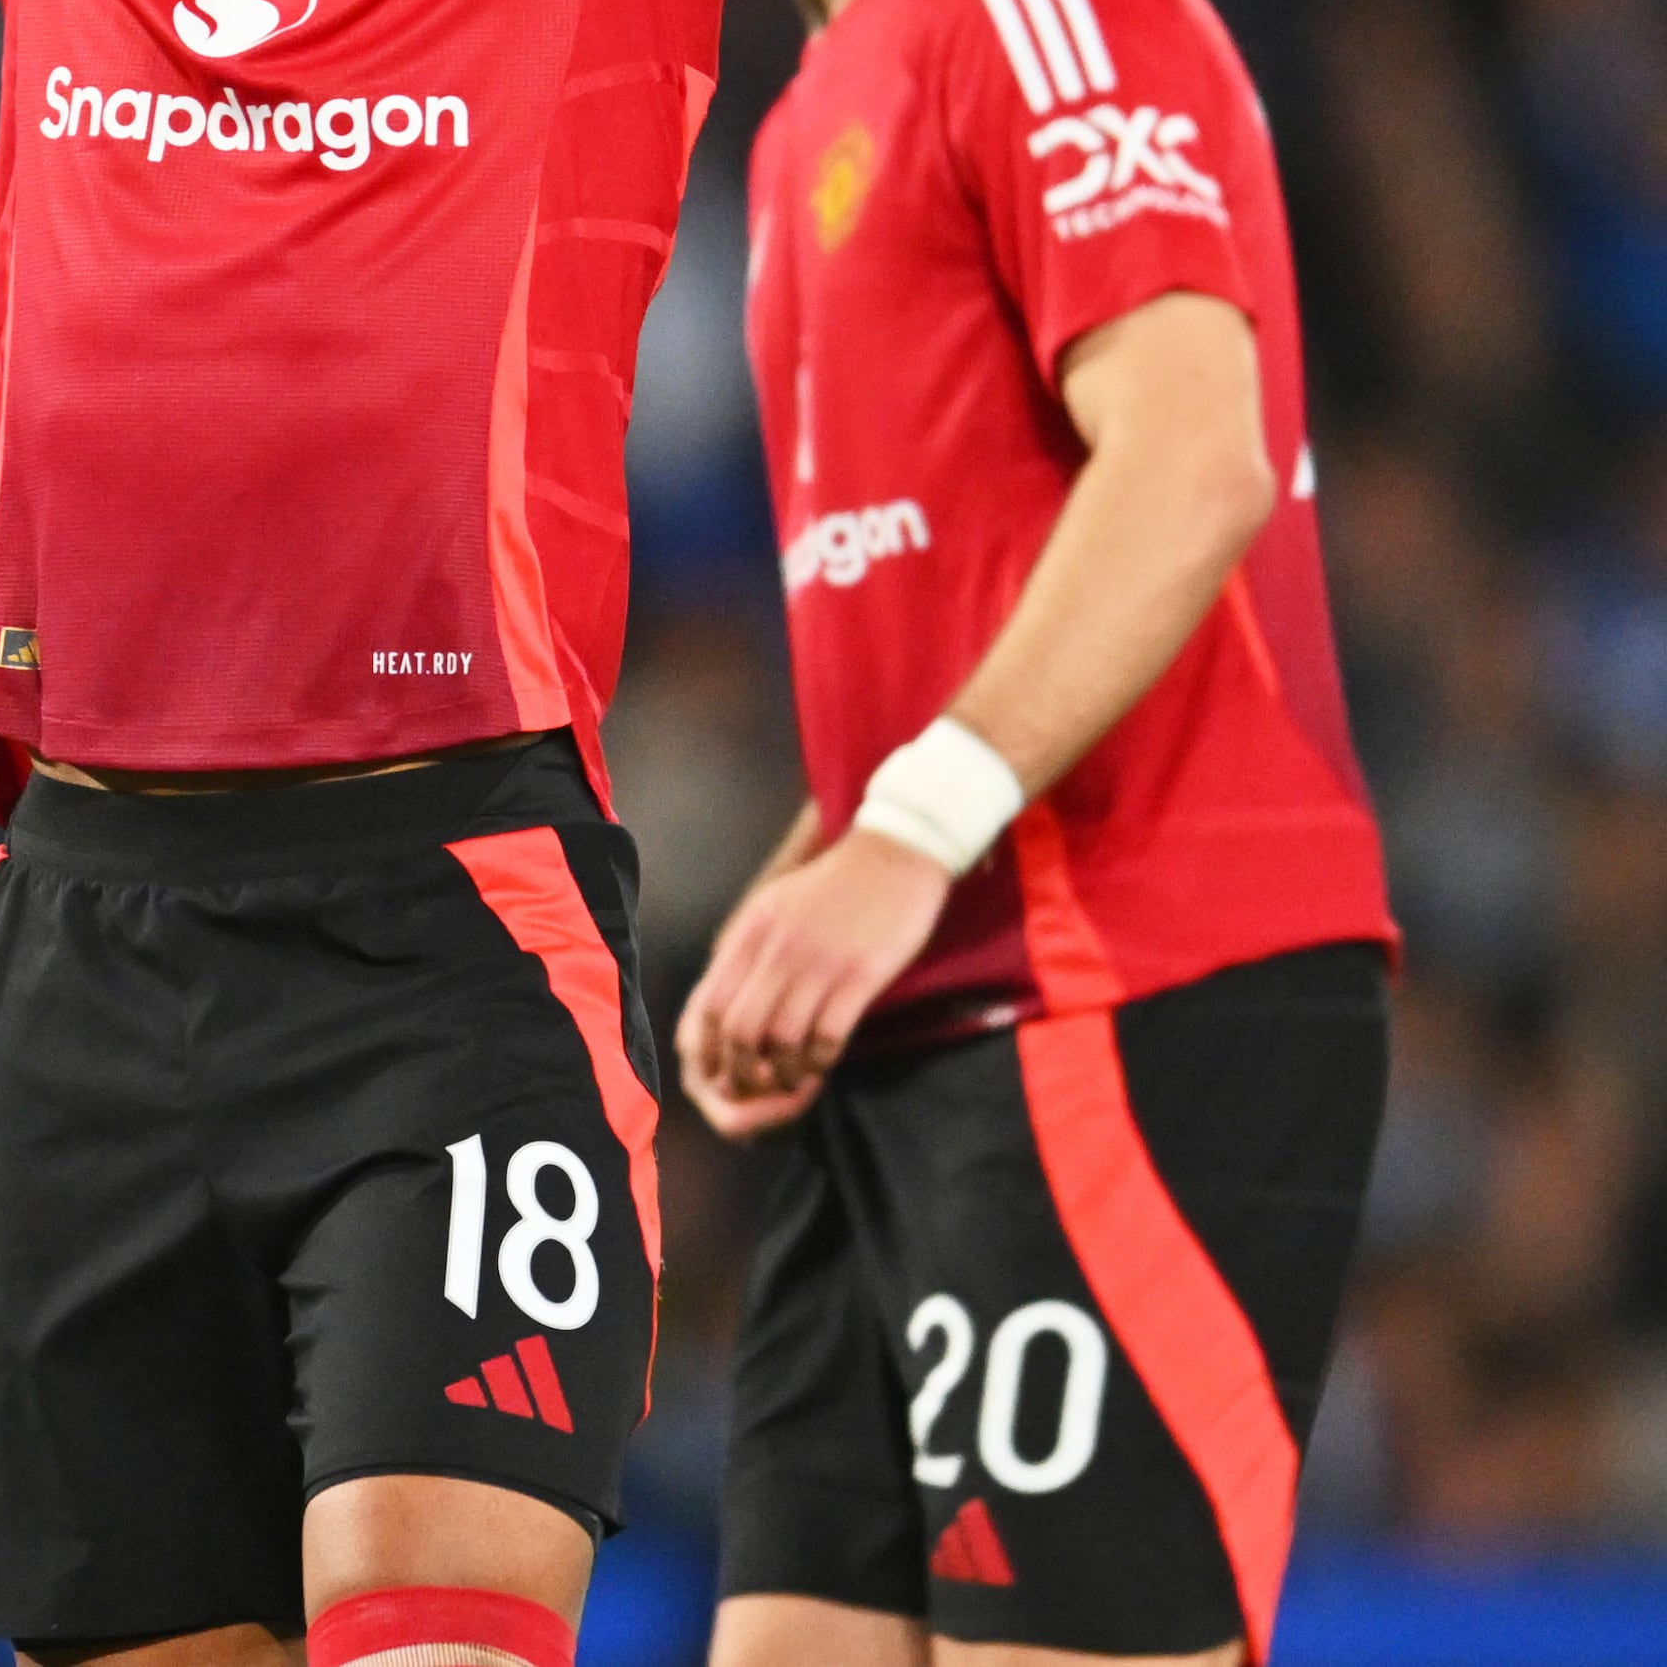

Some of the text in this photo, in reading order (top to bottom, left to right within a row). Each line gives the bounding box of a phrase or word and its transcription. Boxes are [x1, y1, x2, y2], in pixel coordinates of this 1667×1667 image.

[39, 65, 469, 172] Snapdragon
[372, 651, 473, 676] HEAT.RDY
[443, 1133, 600, 1330] 18
[906, 1291, 1109, 1495] 20
